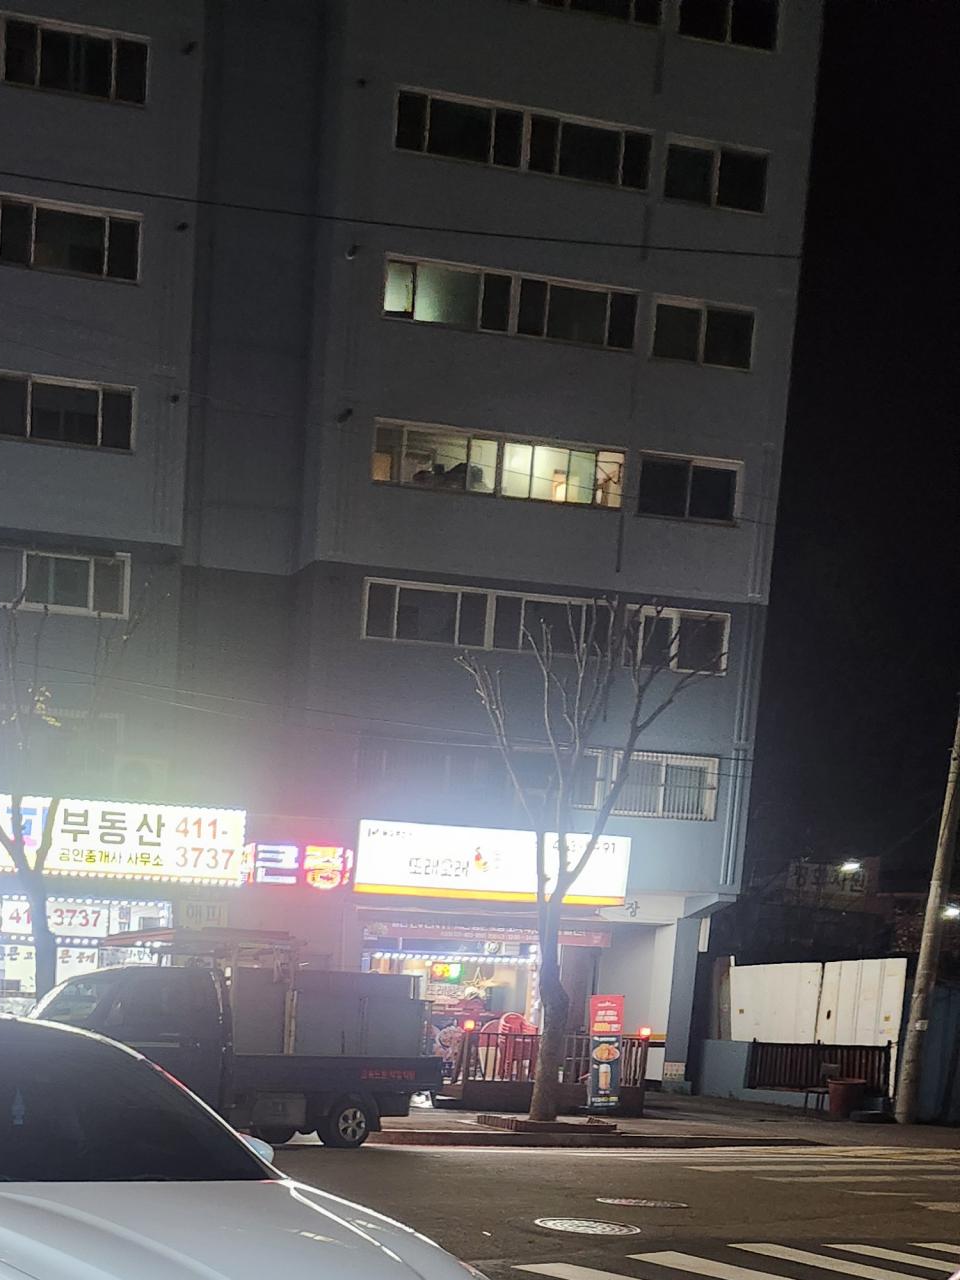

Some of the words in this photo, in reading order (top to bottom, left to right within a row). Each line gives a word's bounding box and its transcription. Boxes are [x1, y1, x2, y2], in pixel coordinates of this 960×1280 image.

[61, 808, 166, 847] 부동산
[175, 817, 228, 840] 411-
[58, 848, 123, 864] 공인중개사
[127, 851, 164, 867] 사무소
[175, 846, 235, 871] 3737
[8, 908, 101, 928] 41-3737
